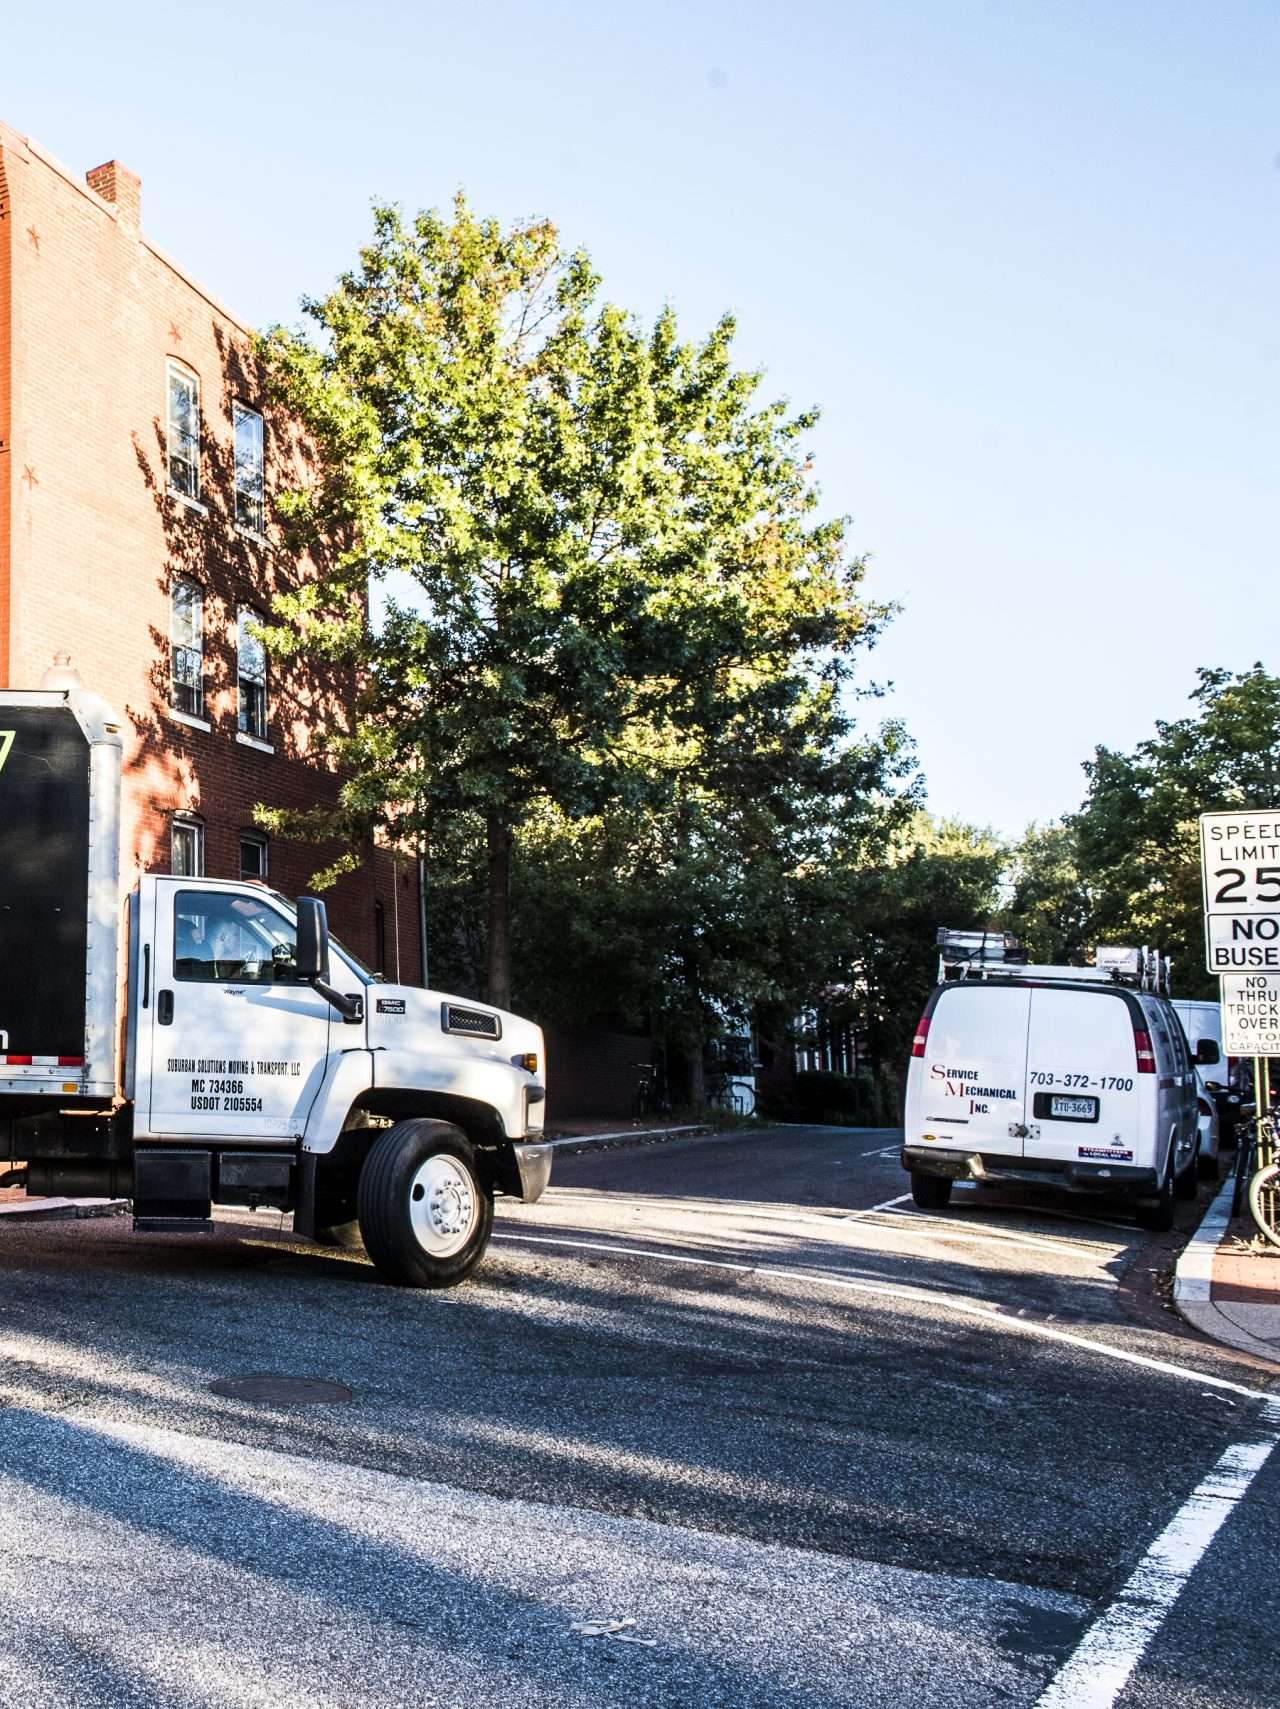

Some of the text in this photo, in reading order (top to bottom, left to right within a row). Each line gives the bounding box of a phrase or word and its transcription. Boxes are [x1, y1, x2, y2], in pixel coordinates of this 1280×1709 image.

[1220, 845, 1280, 861] LIMIT
[1214, 867, 1280, 903] 25
[1232, 918, 1280, 941] NO
[1245, 976, 1267, 989] NO
[1237, 990, 1278, 1002] THRU
[1239, 1017, 1279, 1029] OVER
[1257, 1032, 1280, 1041] TO
[167, 1058, 196, 1072] SUBURBAN
[197, 1060, 227, 1073] SOLUTIONS
[228, 1060, 249, 1074] MOVING
[250, 1062, 255, 1074] &
[291, 1063, 301, 1076] LLC
[191, 1079, 243, 1095] MC 734366
[1030, 1071, 1134, 1092] 703-372-1700
[191, 1096, 263, 1112] USDOT 2105554
